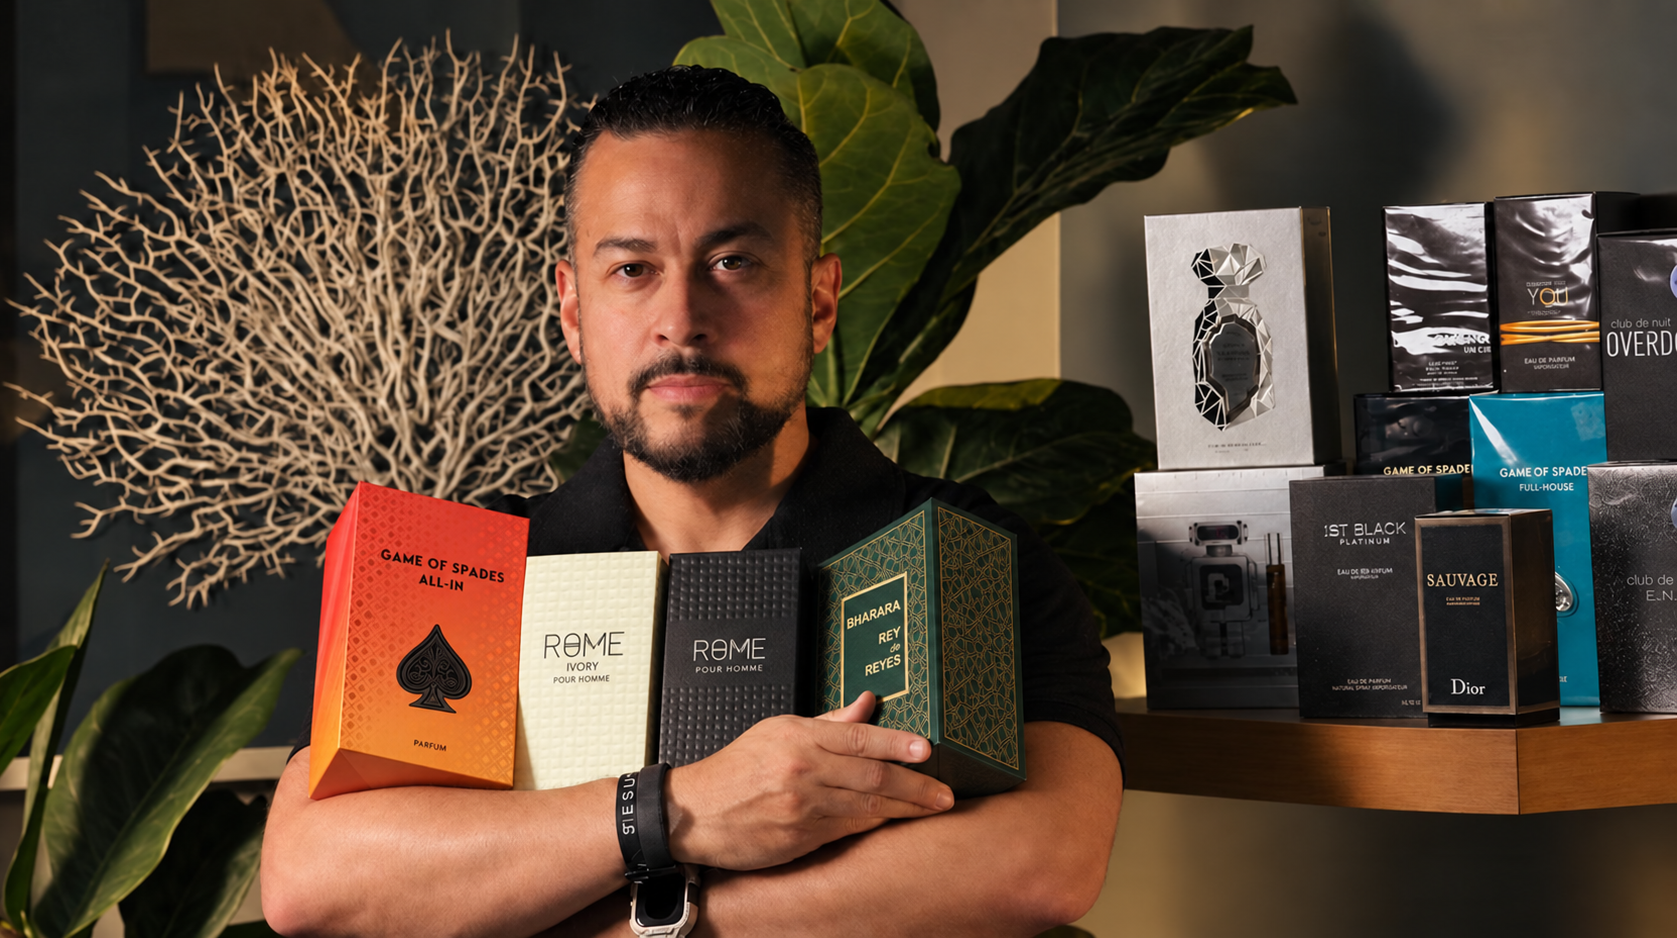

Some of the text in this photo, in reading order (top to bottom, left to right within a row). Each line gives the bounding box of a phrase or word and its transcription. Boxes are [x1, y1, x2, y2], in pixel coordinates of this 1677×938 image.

[1527, 287, 1569, 307] YOU
[1610, 317, 1671, 329] club de nuit
[1606, 330, 1677, 357] OVERD
[1383, 464, 1474, 476] GAME OF SPADE
[1499, 467, 1532, 478] GAME
[1534, 467, 1549, 477] OF
[1519, 482, 1574, 492] FULL-HOUSE
[1354, 521, 1406, 536] BLACK
[1339, 537, 1390, 545] PLATINUM
[380, 549, 505, 582] GAME OF SPADES
[418, 574, 464, 591] ALL-IN
[1427, 573, 1499, 587] SAUVAGE
[1626, 574, 1674, 586] club de
[846, 599, 901, 630] BHARARA
[878, 626, 901, 645] REY
[543, 631, 625, 659] ROME
[693, 637, 767, 662] ROME
[566, 661, 599, 672] IVORY
[695, 664, 763, 674] POUR HOMME
[865, 654, 901, 677] REYES
[553, 674, 610, 684] POUR HOMME
[1450, 678, 1486, 695] Dior
[413, 739, 447, 751] PARFUM
